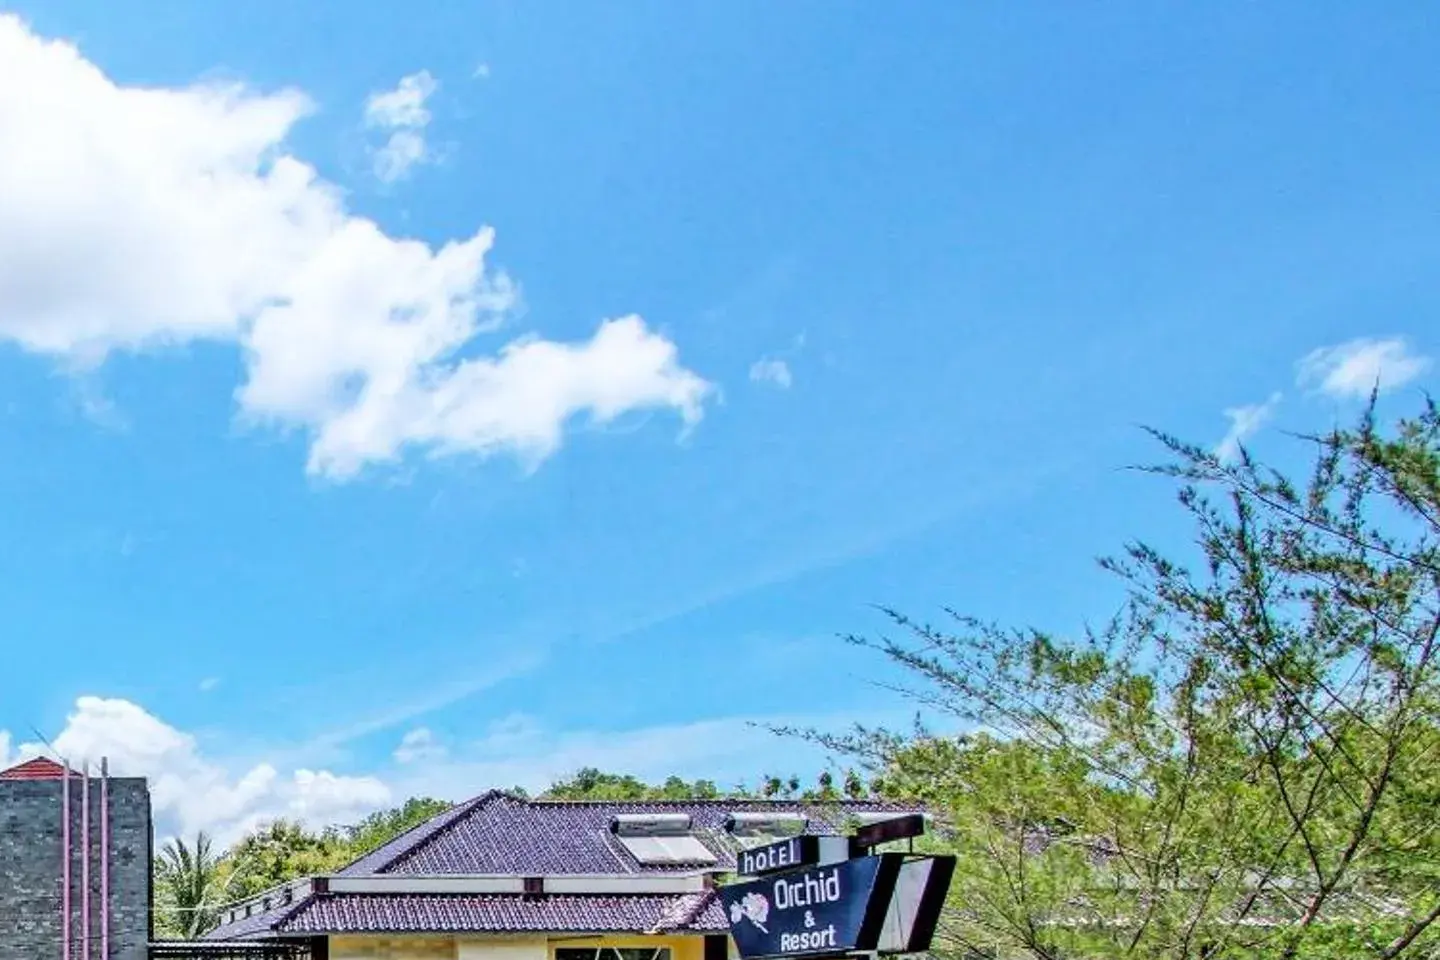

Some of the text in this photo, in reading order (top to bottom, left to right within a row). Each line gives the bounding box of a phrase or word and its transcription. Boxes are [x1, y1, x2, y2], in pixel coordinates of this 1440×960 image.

[774, 868, 840, 909] Orchid
[804, 910, 816, 928] &
[780, 924, 837, 952] Resort
